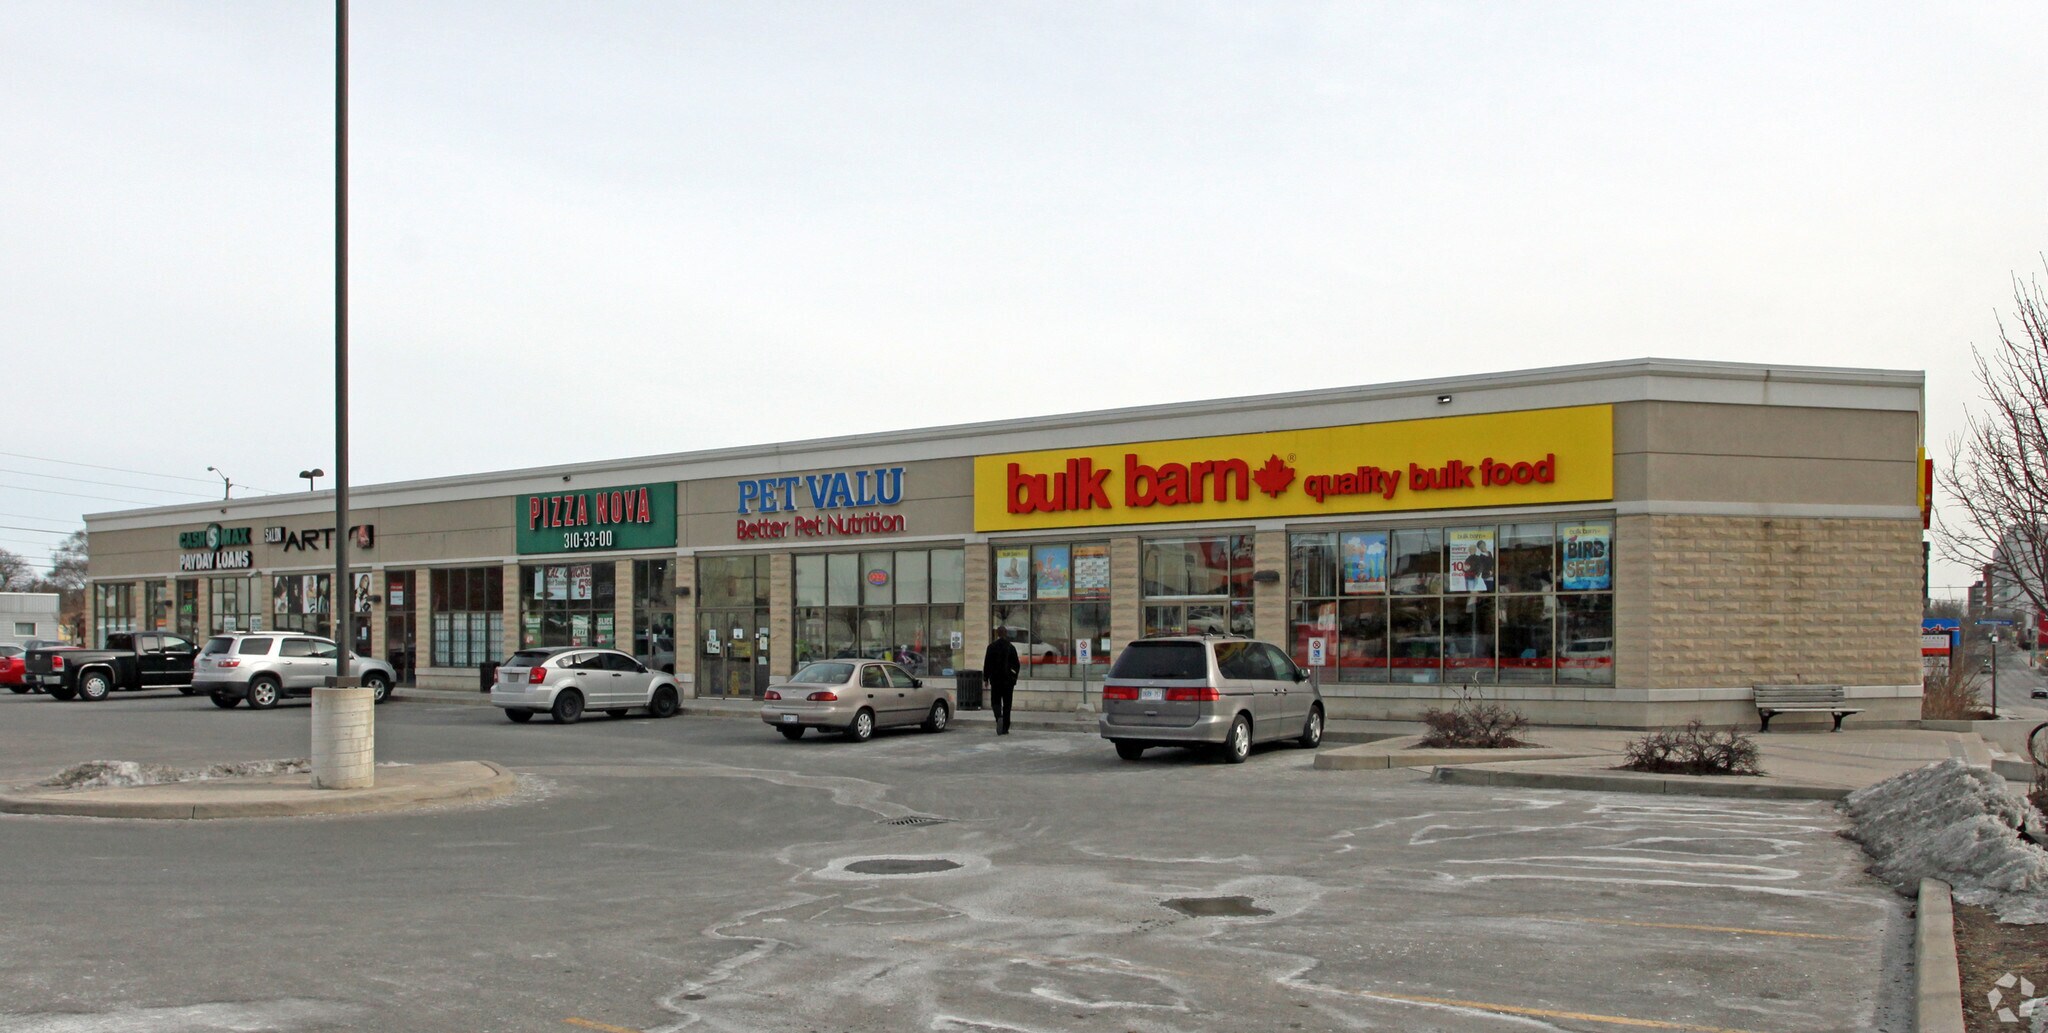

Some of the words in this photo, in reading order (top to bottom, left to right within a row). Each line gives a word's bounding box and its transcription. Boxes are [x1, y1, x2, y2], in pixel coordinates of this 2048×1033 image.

[737, 477, 800, 514] PET
[806, 467, 905, 510] VALU
[1007, 457, 1113, 514] bulk
[1125, 453, 1250, 507] barn
[1304, 466, 1401, 503] quality
[1409, 459, 1475, 491] bulk
[1480, 453, 1555, 486] food
[529, 494, 588, 530] PIZZA
[596, 487, 650, 525] NOVA
[179, 531, 206, 549] CASH
[220, 527, 251, 546] MAX
[737, 518, 791, 540] Better
[794, 514, 825, 537] Pet
[827, 511, 906, 535] Nutrition
[563, 530, 613, 549] 310-33-00
[1568, 541, 1605, 558] BIRD
[180, 552, 214, 571] PAYDAY
[216, 550, 250, 569] LOANS
[1566, 559, 1606, 578] SEED
